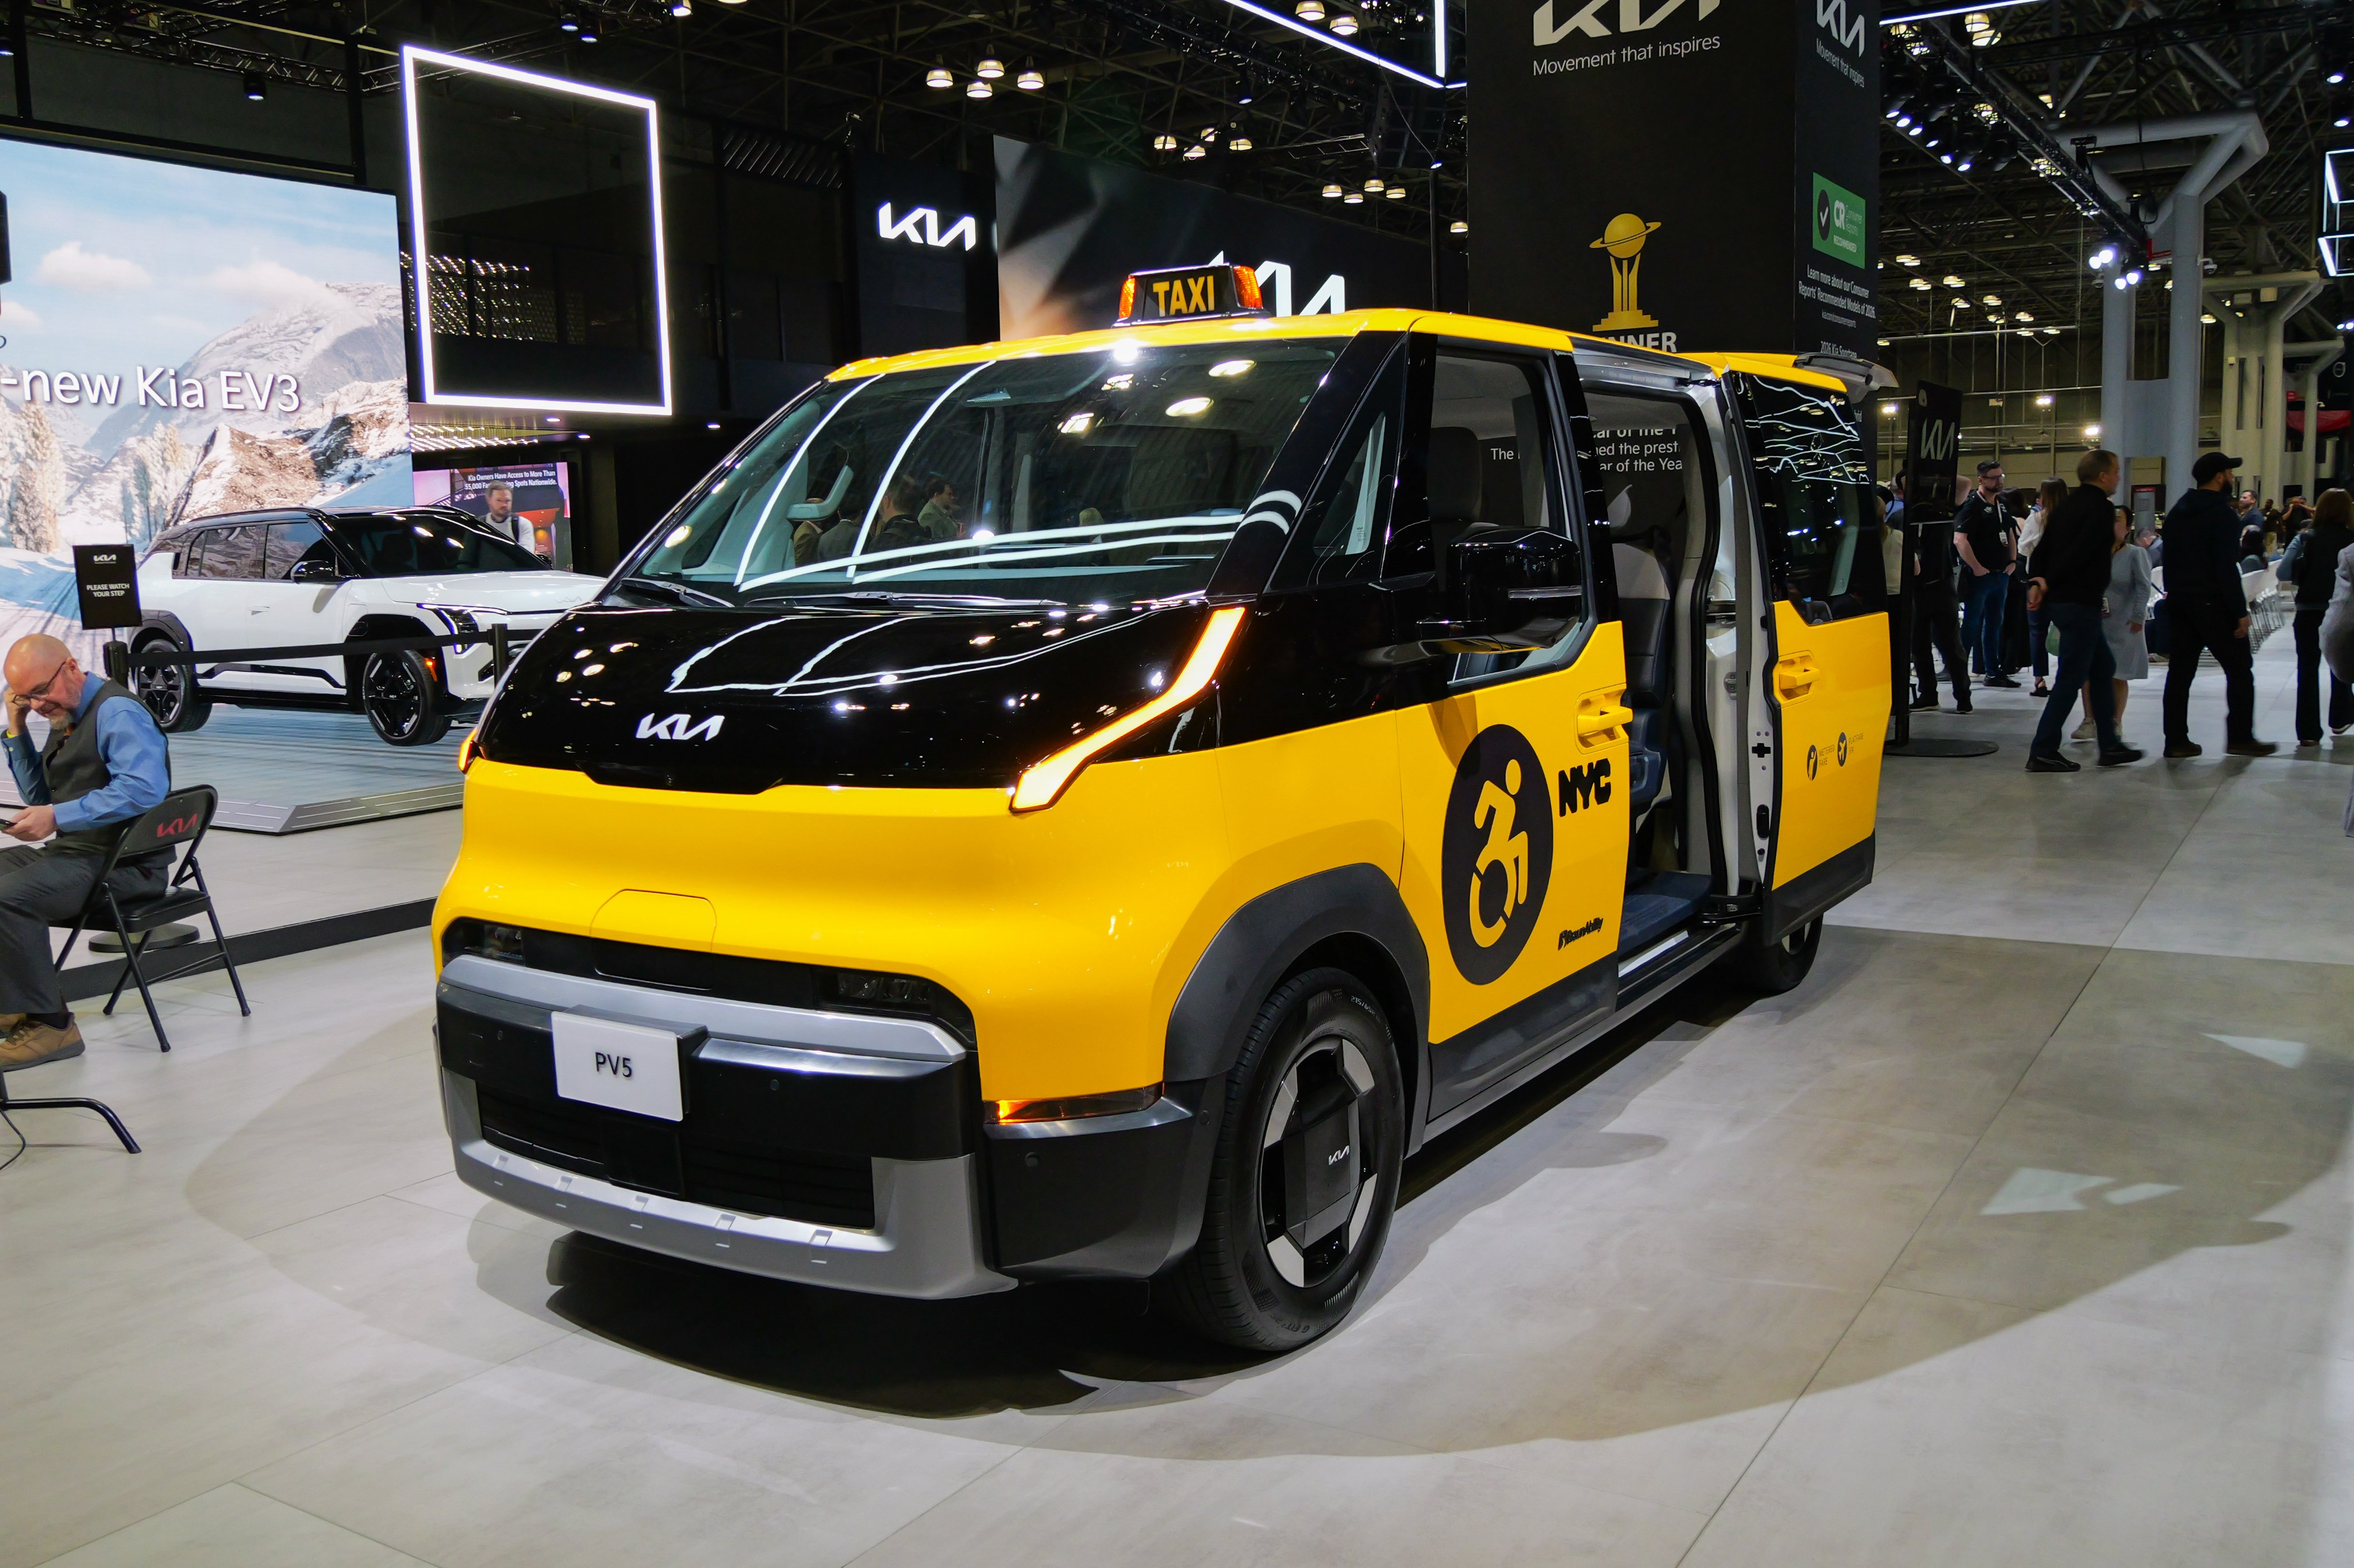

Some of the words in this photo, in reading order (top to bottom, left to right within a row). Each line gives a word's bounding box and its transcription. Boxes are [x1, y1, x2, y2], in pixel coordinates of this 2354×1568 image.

[1817, 0, 1865, 57] KIA
[1533, 49, 1616, 76] Movement
[1621, 44, 1653, 63] that
[1659, 36, 1720, 57] inspires
[1817, 38, 1840, 70] Movement
[1840, 58, 1849, 76] that
[1849, 65, 1864, 87] inspires
[879, 202, 976, 252] KIA
[1834, 200, 1845, 230] CR
[1153, 275, 1215, 317] TAXI
[1209, 251, 1345, 317] IA
[1807, 264, 1820, 281] Learn
[1820, 272, 1831, 286] more
[1832, 274, 1843, 290] about
[1851, 281, 1870, 299] Consumer
[1817, 287, 1847, 309] Recommended
[1847, 298, 1861, 314] Models
[1861, 303, 1866, 315] of
[137, 366, 205, 409] Kia
[220, 371, 301, 413] EV3
[1490, 448, 1514, 460] The
[1618, 442, 1640, 455] the
[1644, 440, 1680, 457] prest
[1921, 418, 1955, 460] KIA
[1599, 462, 1613, 471] ar
[1616, 459, 1630, 472] of
[1633, 459, 1655, 471] the
[1659, 457, 1683, 471] Yea
[465, 483, 482, 491] 55,000
[514, 480, 528, 488] Spots
[528, 478, 557, 486] Nationwide.
[636, 712, 726, 741] KIA
[1559, 758, 1611, 818] NYC
[157, 813, 198, 837] KIA
[595, 1051, 633, 1078] PV5
[1328, 1145, 1350, 1166] KIA
